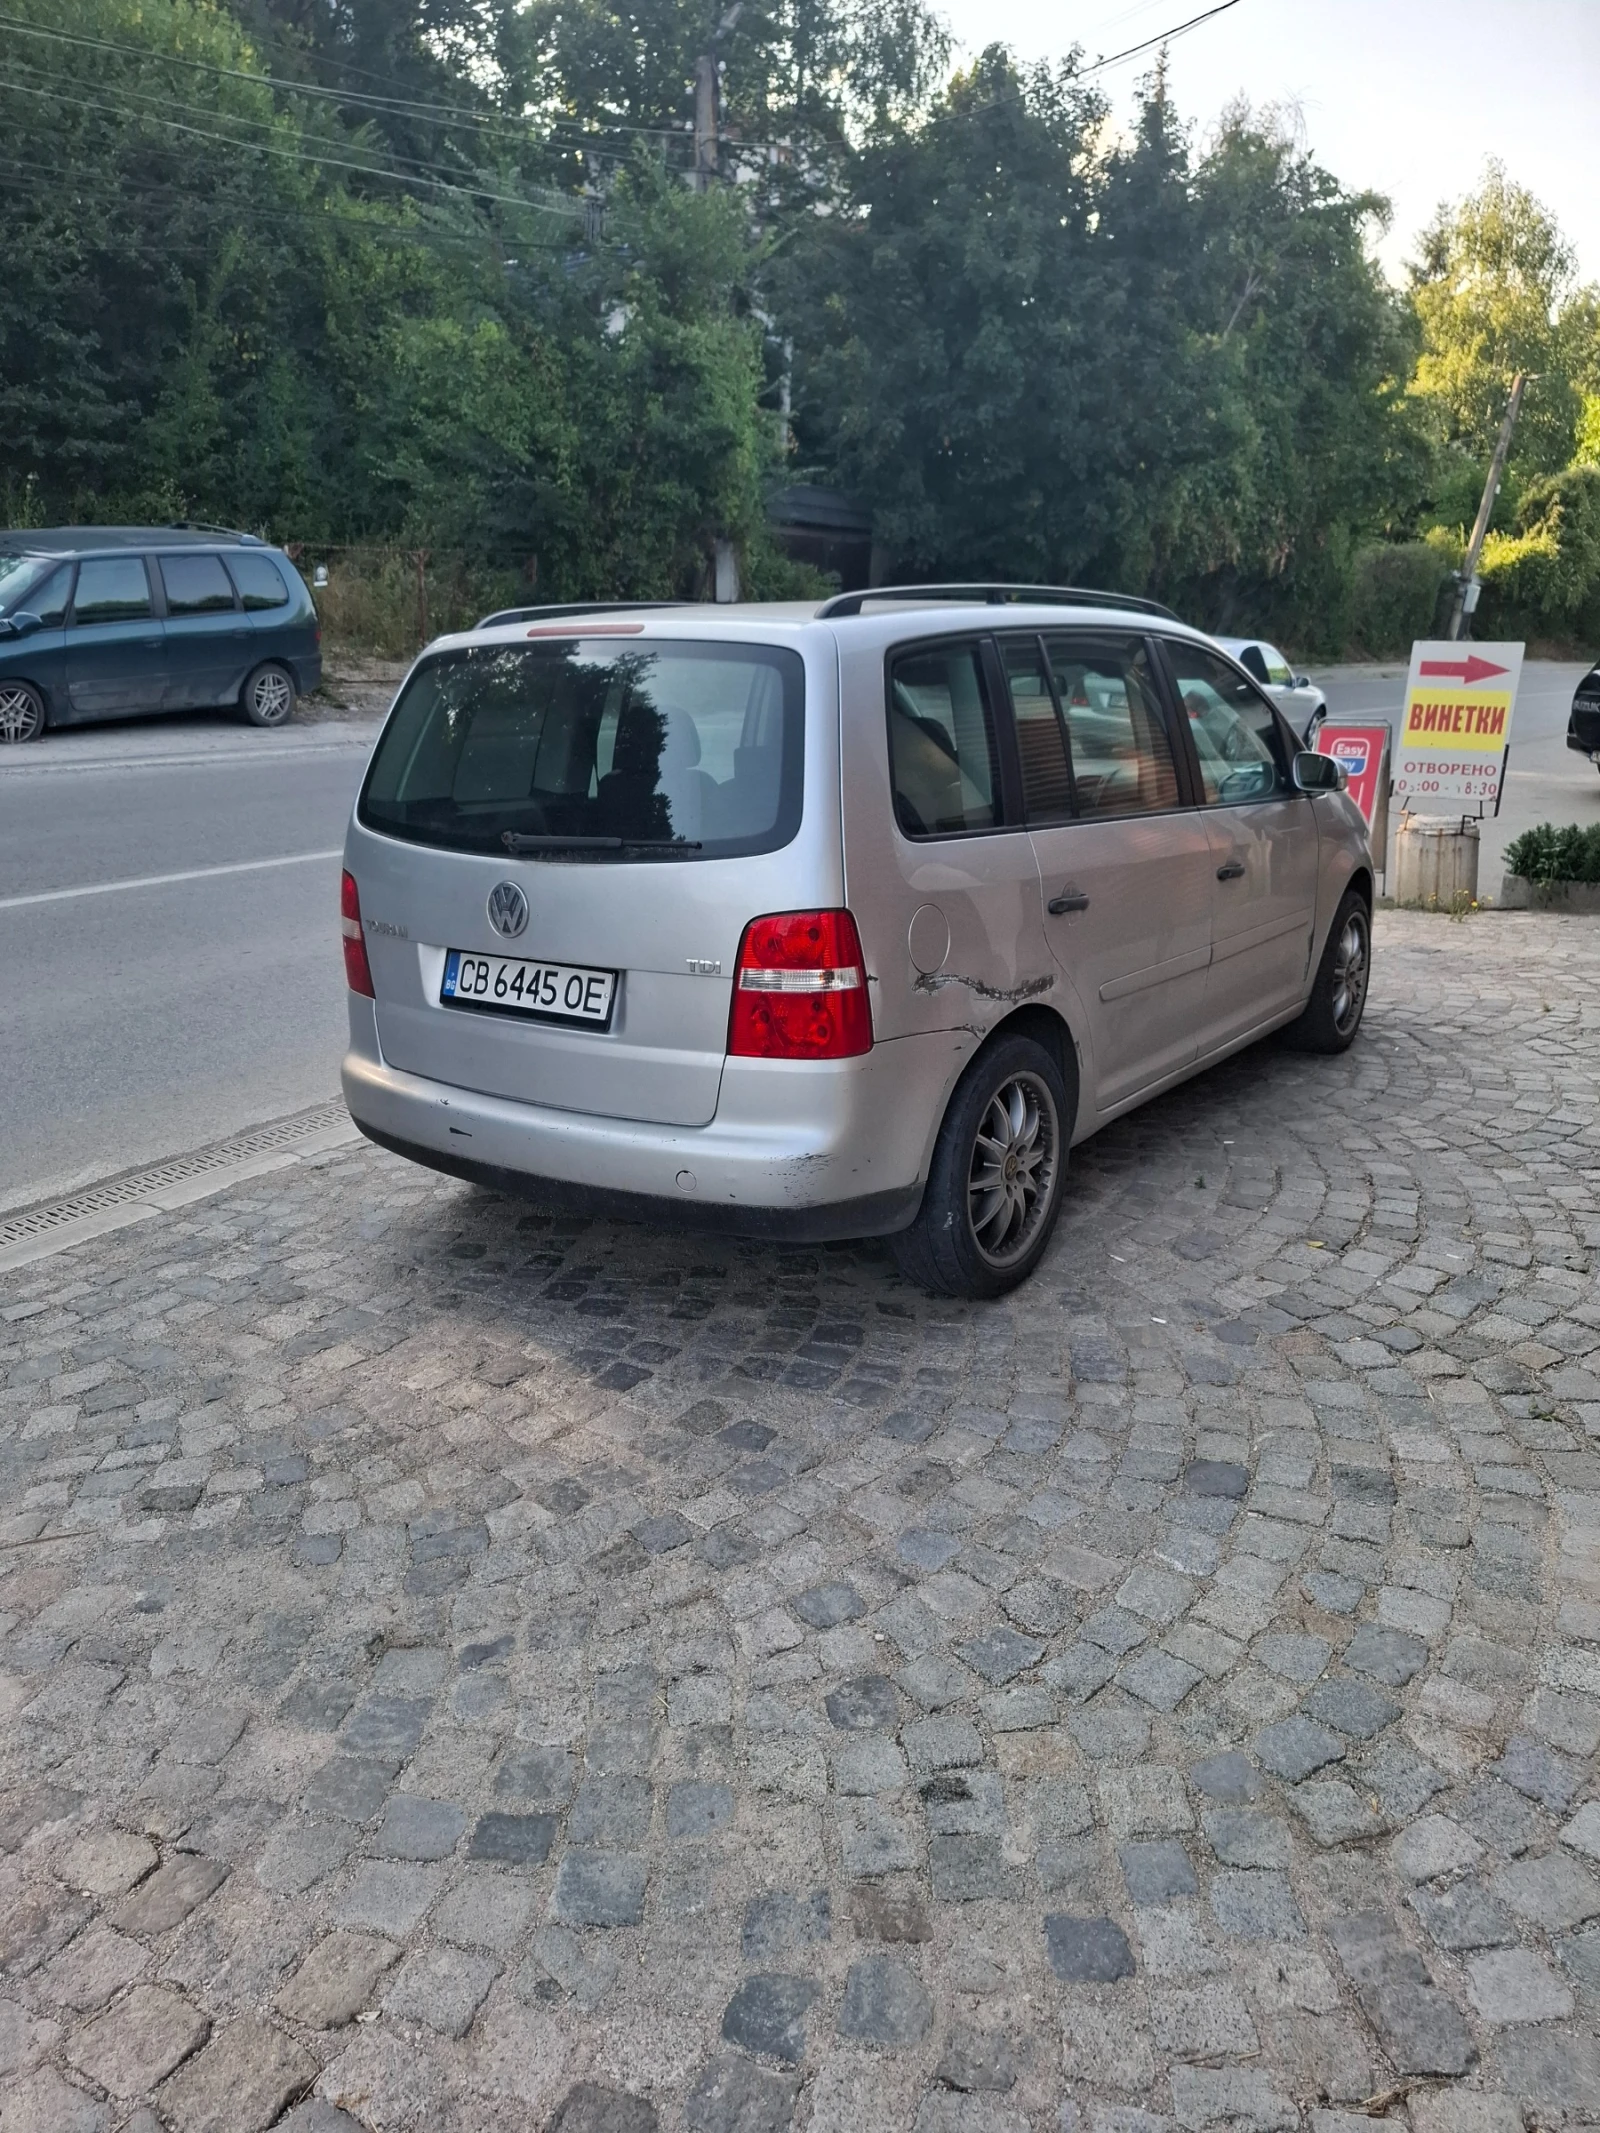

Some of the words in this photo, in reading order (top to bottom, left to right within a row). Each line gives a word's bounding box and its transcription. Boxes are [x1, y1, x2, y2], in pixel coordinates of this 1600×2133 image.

[1408, 703, 1505, 735] ВИНЕТКИ
[1336, 743, 1364, 757] Easy
[1404, 761, 1497, 777] ОТВОРЕНО
[686, 958, 721, 974] TDI
[445, 979, 456, 991] BG
[459, 959, 490, 995] CB
[494, 964, 559, 1006] 6445
[564, 974, 606, 1014] OE
